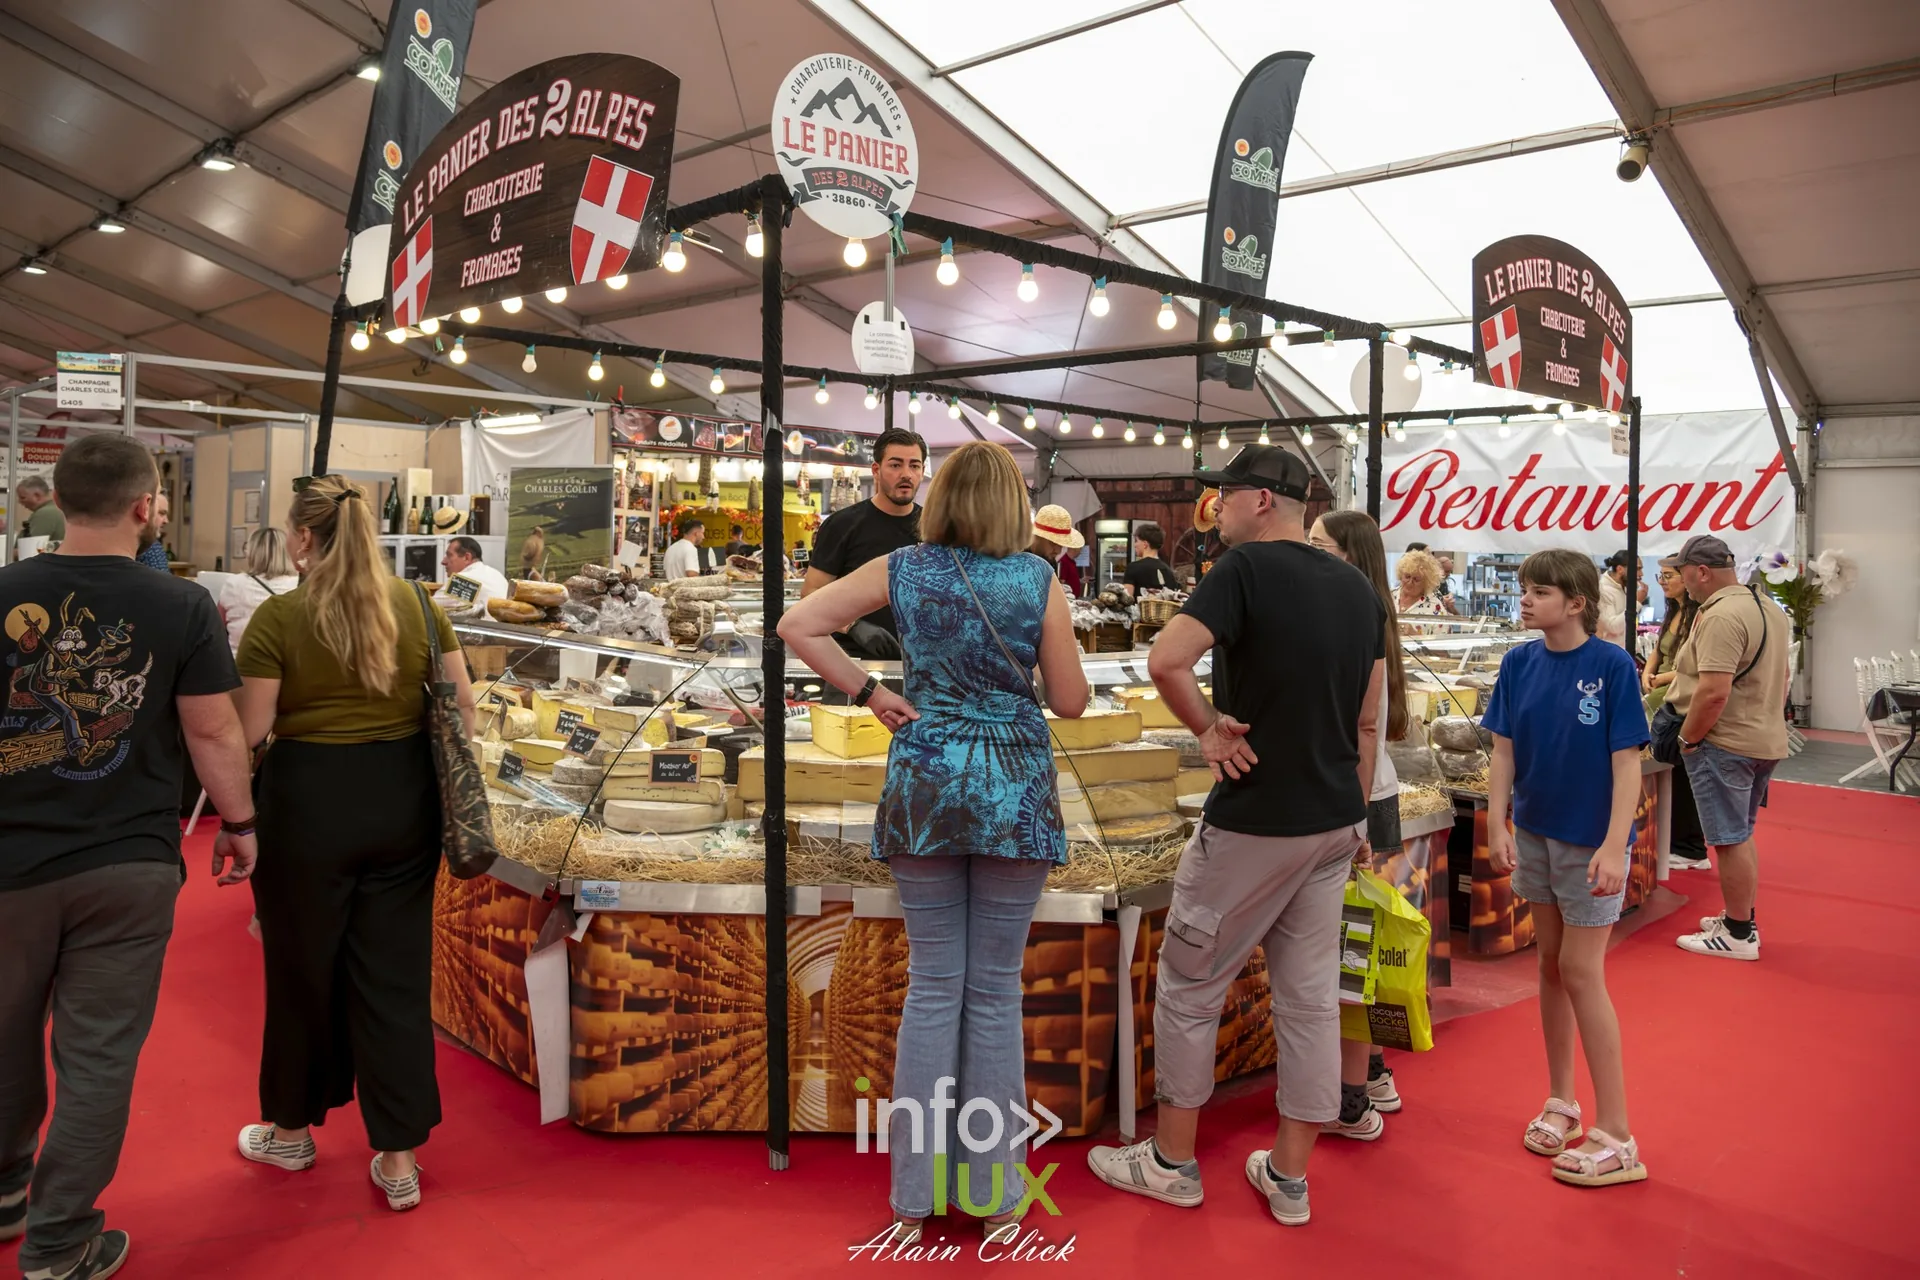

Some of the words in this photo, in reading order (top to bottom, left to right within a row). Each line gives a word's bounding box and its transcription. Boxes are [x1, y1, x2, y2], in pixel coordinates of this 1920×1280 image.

[403, 180, 425, 235] LE
[428, 119, 491, 201] PANIER
[496, 96, 539, 150] DES
[540, 78, 572, 139] 2
[569, 89, 655, 151] ALPES
[782, 116, 816, 154] LE
[822, 126, 910, 175] PANIER
[463, 162, 544, 217] CHARCUTERIE
[812, 171, 834, 186] DES
[836, 170, 849, 187] 2
[851, 174, 885, 200] ALPES
[832, 193, 866, 208] 38860
[490, 213, 501, 243] &
[460, 245, 522, 288] FROMAGES
[1484, 267, 1507, 306] LE
[1506, 258, 1553, 296] PANIER
[1556, 261, 1579, 297] DES
[1581, 269, 1594, 308] 2
[1594, 288, 1626, 345] ALPES
[1540, 306, 1586, 338] CHARCUTERIE
[1560, 338, 1567, 359] &
[1545, 361, 1580, 387] FROMAGES
[524, 484, 563, 493] CHARLES
[565, 484, 598, 494] COLLIN
[1578, 697, 1600, 725] S
[1369, 1006, 1406, 1018] Jacques
[1369, 1014, 1408, 1027] Bockel
